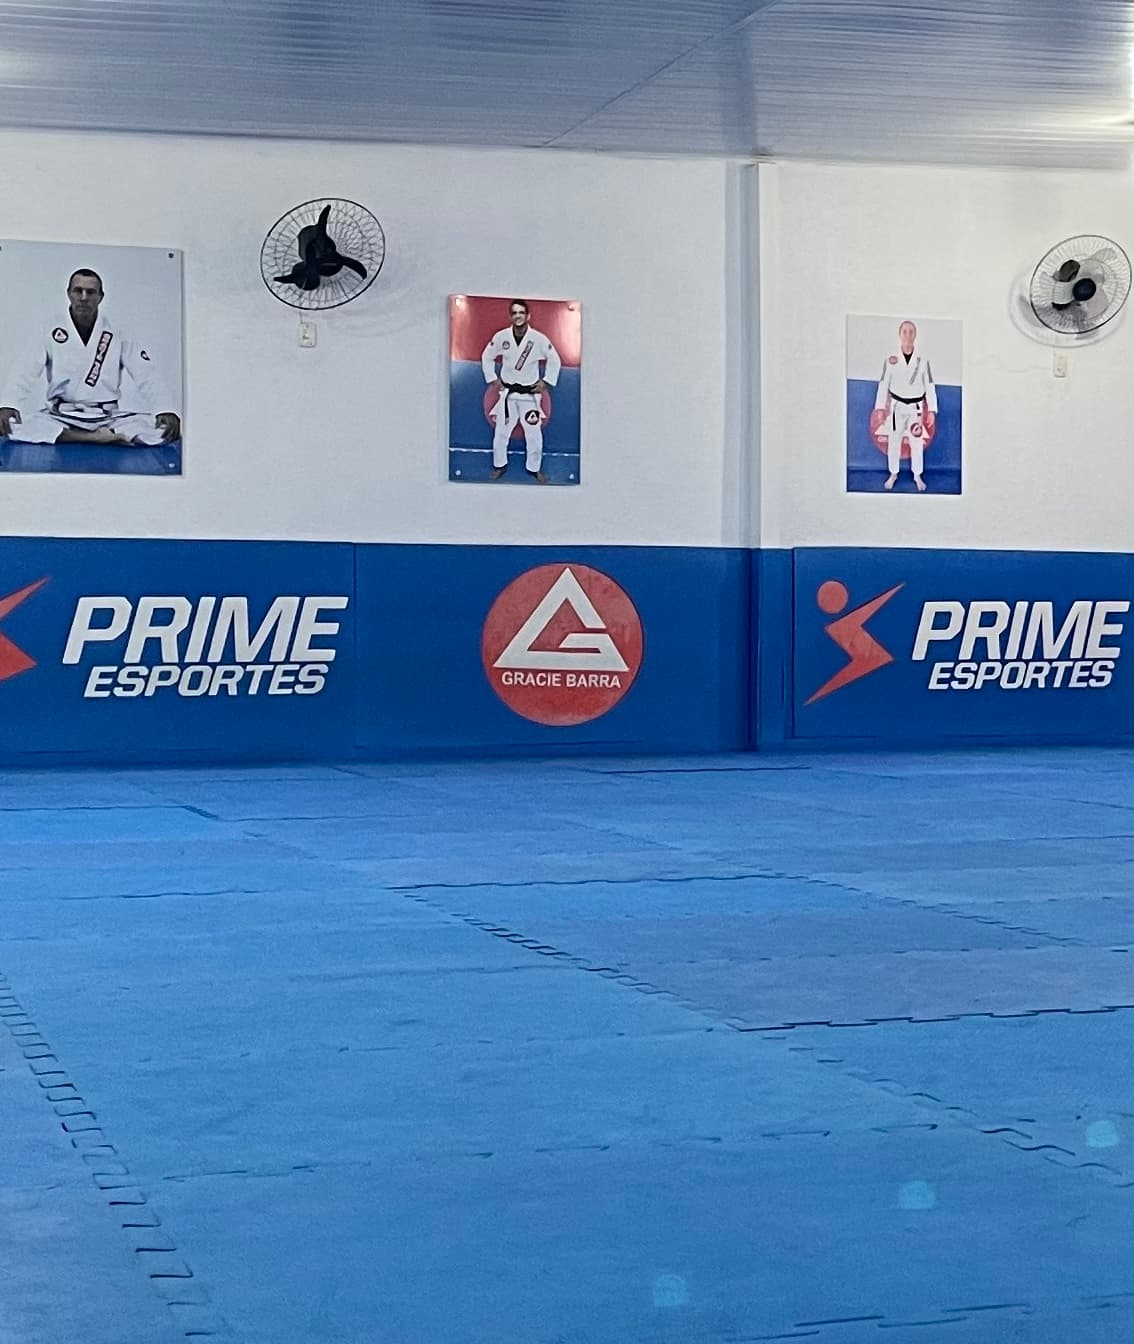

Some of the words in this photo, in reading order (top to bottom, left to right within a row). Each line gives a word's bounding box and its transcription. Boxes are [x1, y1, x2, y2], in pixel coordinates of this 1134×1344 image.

[62, 596, 349, 665] PRIME
[911, 600, 1131, 661] PRIME
[84, 663, 328, 698] ESPORTES
[501, 671, 562, 687] GRACIE
[566, 673, 621, 688] BARRA
[928, 660, 1115, 690] ESPORTES
